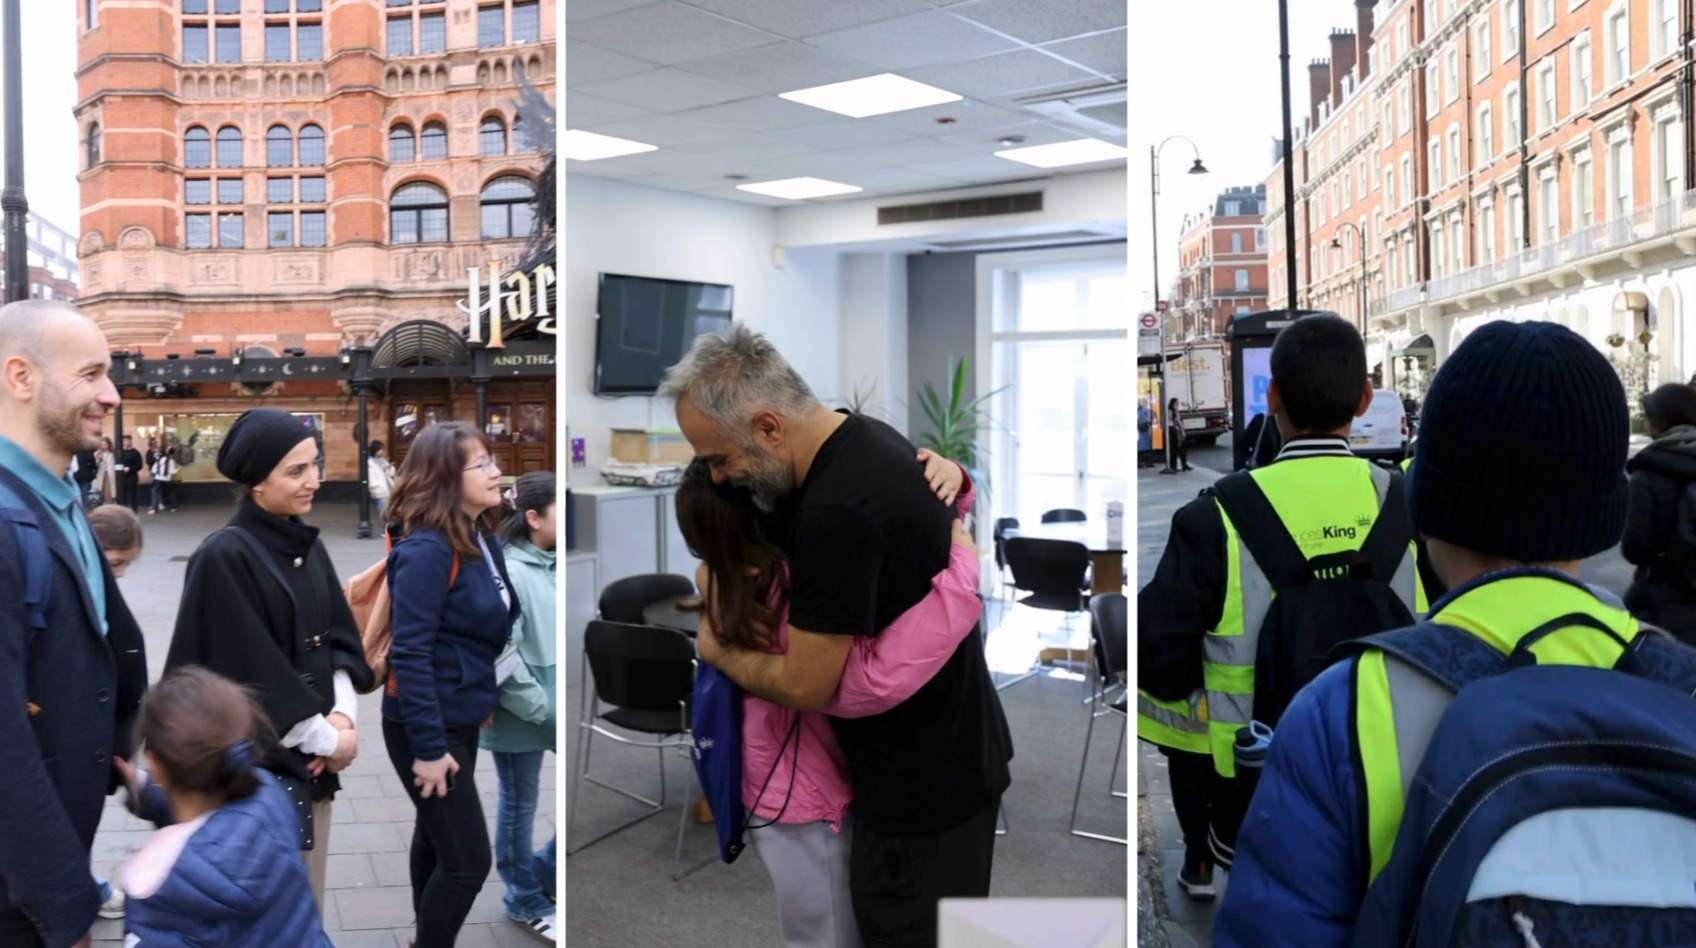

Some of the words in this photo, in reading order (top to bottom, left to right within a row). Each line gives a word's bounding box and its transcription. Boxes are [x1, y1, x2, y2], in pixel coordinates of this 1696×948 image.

[456, 260, 556, 349] Har
[493, 355, 522, 366] AND
[525, 354, 549, 365] THE
